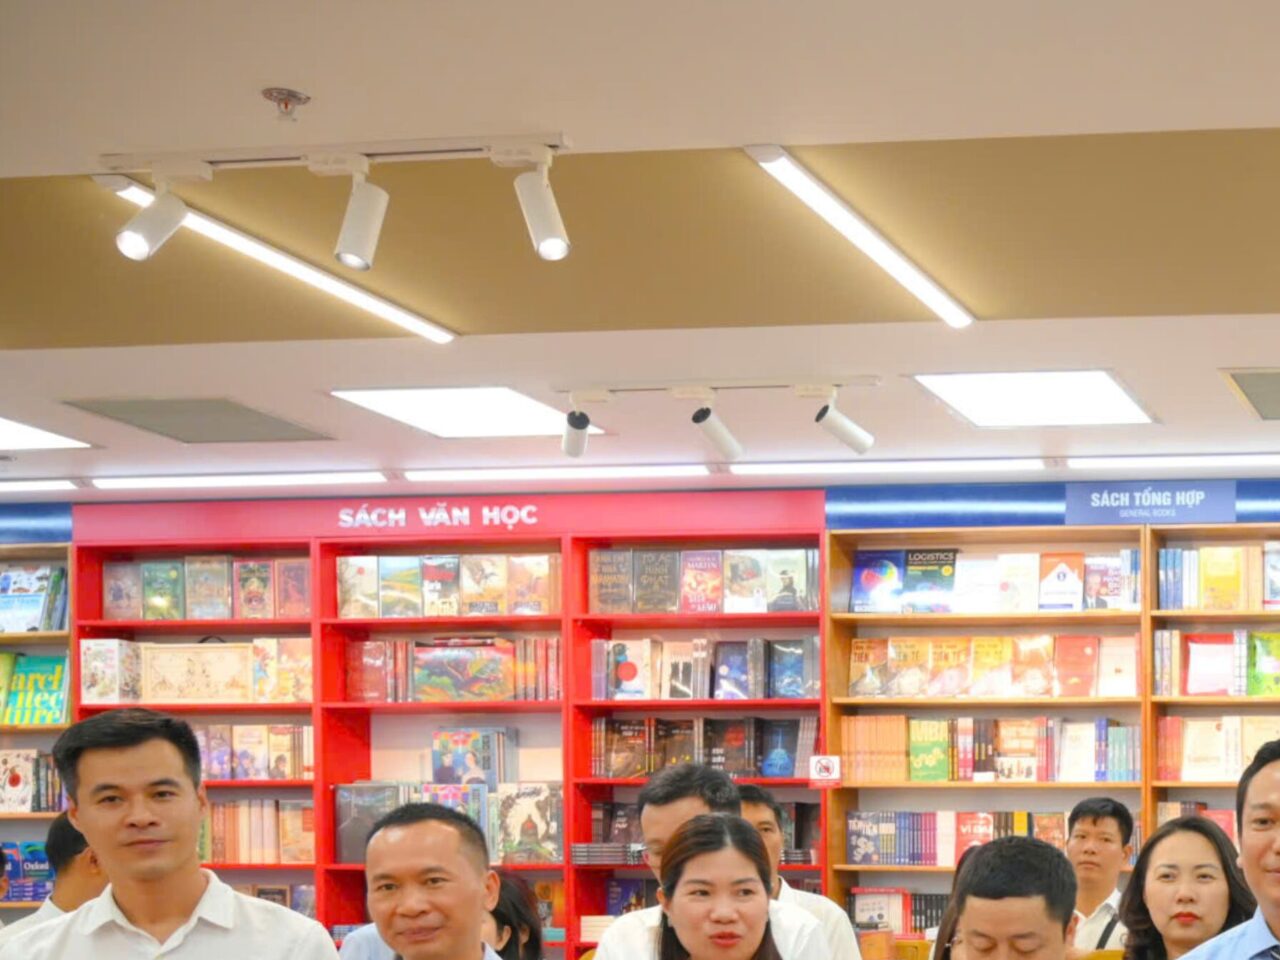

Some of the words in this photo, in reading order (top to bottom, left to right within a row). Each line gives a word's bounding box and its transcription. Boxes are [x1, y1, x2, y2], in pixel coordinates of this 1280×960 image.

[1091, 489, 1129, 508] SÁCH
[1134, 486, 1172, 507] TỔNG
[1175, 489, 1206, 509] HỢP
[338, 503, 406, 529] SÁCH
[418, 502, 471, 526] VĂN
[482, 505, 538, 531] HỌC
[908, 552, 954, 561] LOGISTICS
